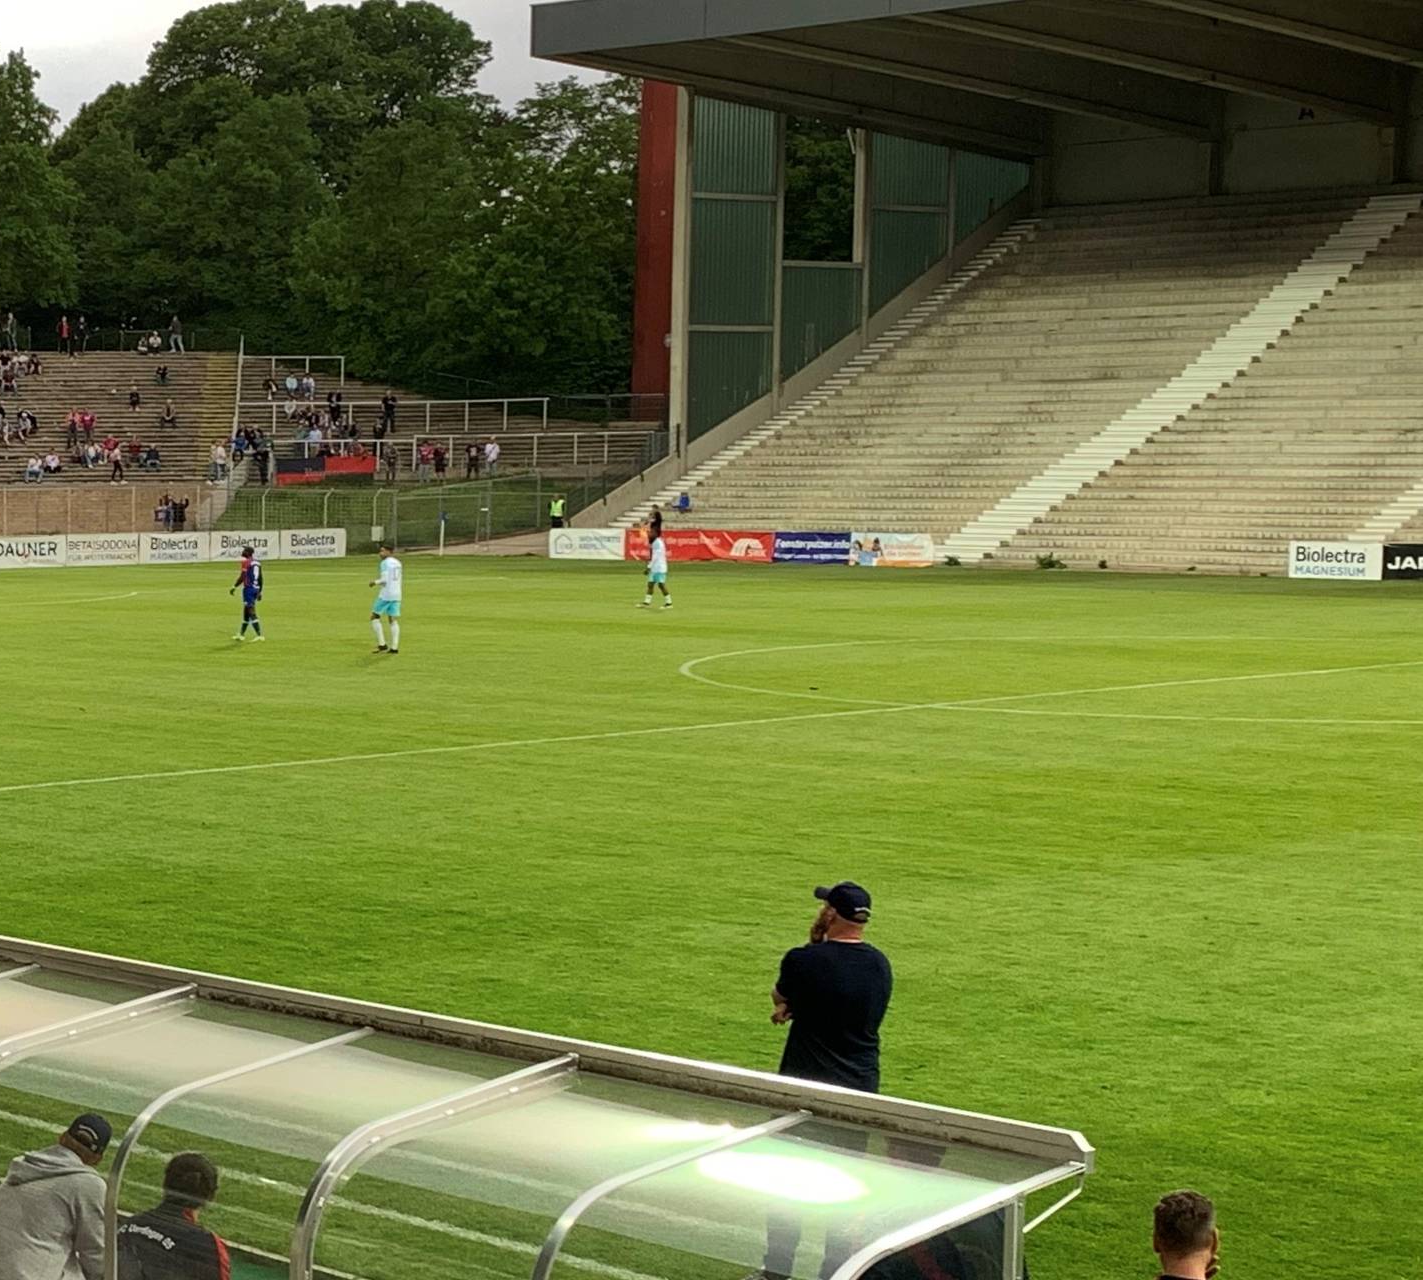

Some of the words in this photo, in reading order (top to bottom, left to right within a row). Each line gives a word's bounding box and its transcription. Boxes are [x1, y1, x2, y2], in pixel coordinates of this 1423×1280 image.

[151, 538, 198, 550] Biolectra
[221, 535, 268, 548] Biolectra
[291, 534, 335, 546] Biolectra
[1296, 546, 1366, 563] Biolectra
[1295, 565, 1366, 577] MAGNESIUM
